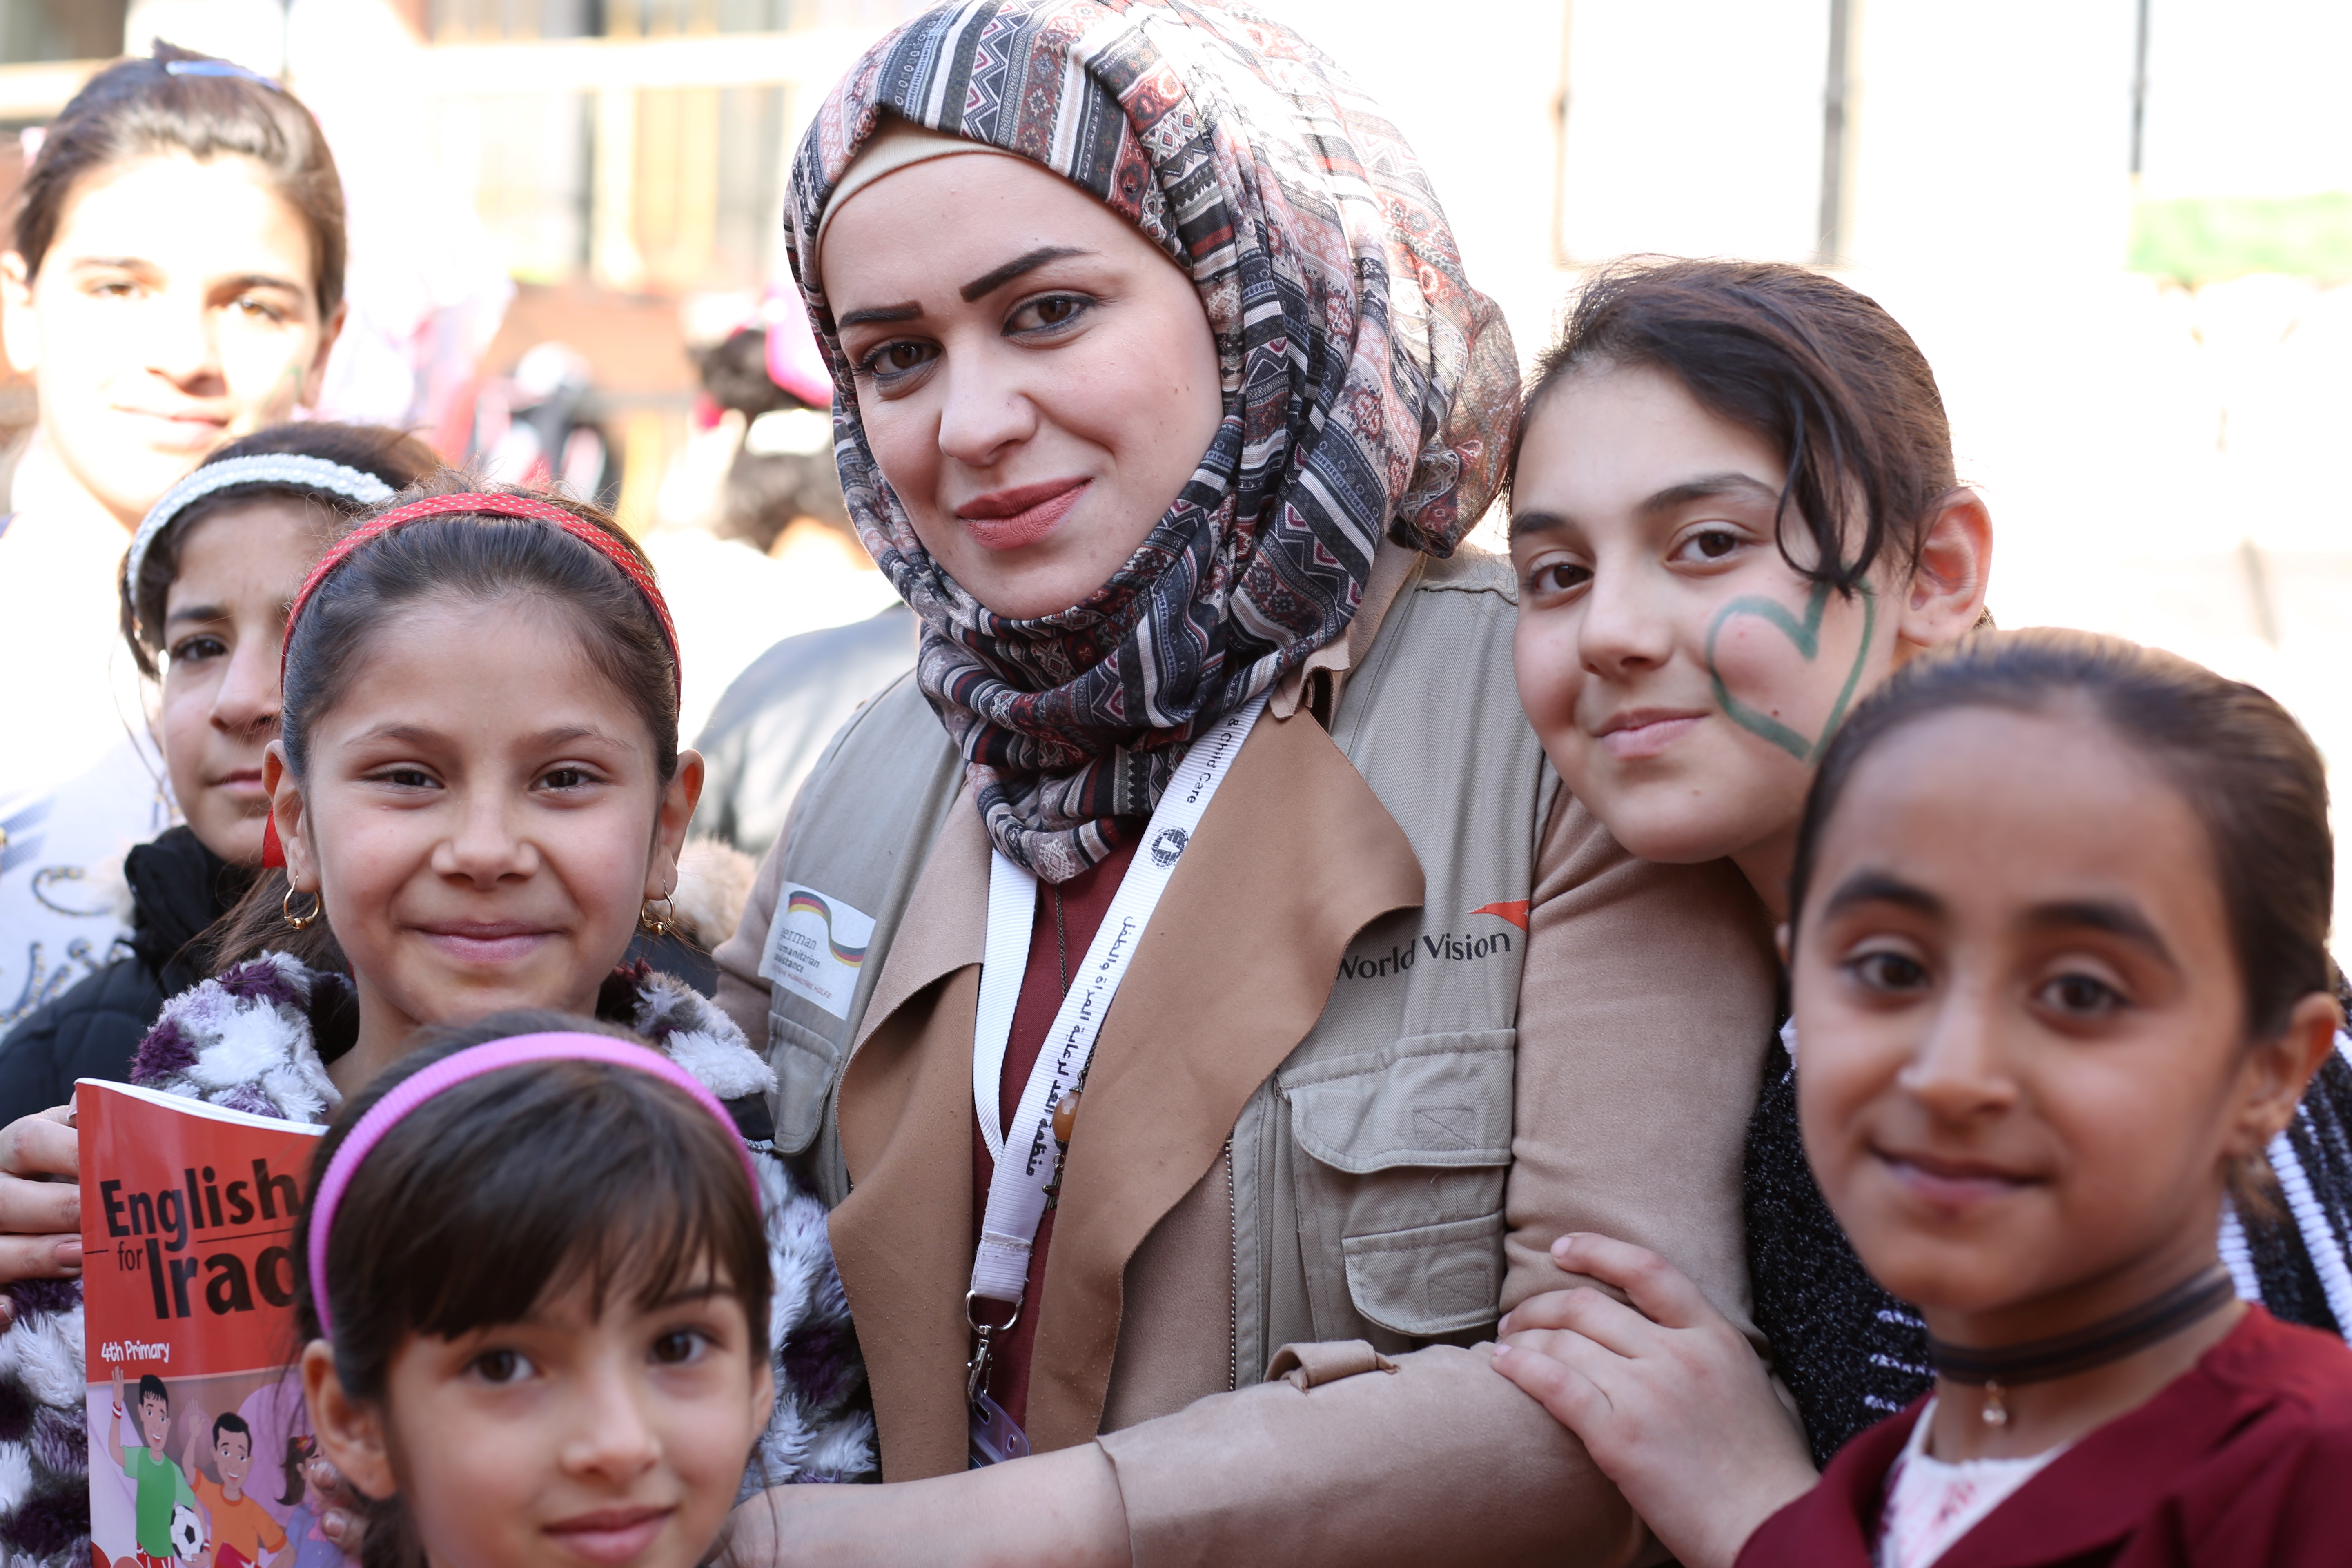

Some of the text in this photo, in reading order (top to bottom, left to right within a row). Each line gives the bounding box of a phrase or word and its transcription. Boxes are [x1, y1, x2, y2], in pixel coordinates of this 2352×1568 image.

[1187, 718, 1239, 803] & Child Care
[1336, 933, 1510, 980] World Vision
[1026, 1118, 1052, 1176] منظمة
[1058, 1025, 1085, 1076] لرعاية
[1099, 916, 1136, 970] والطفل
[100, 1158, 301, 1252] English
[118, 1241, 143, 1271] for
[101, 1340, 169, 1363] 4th Primary
